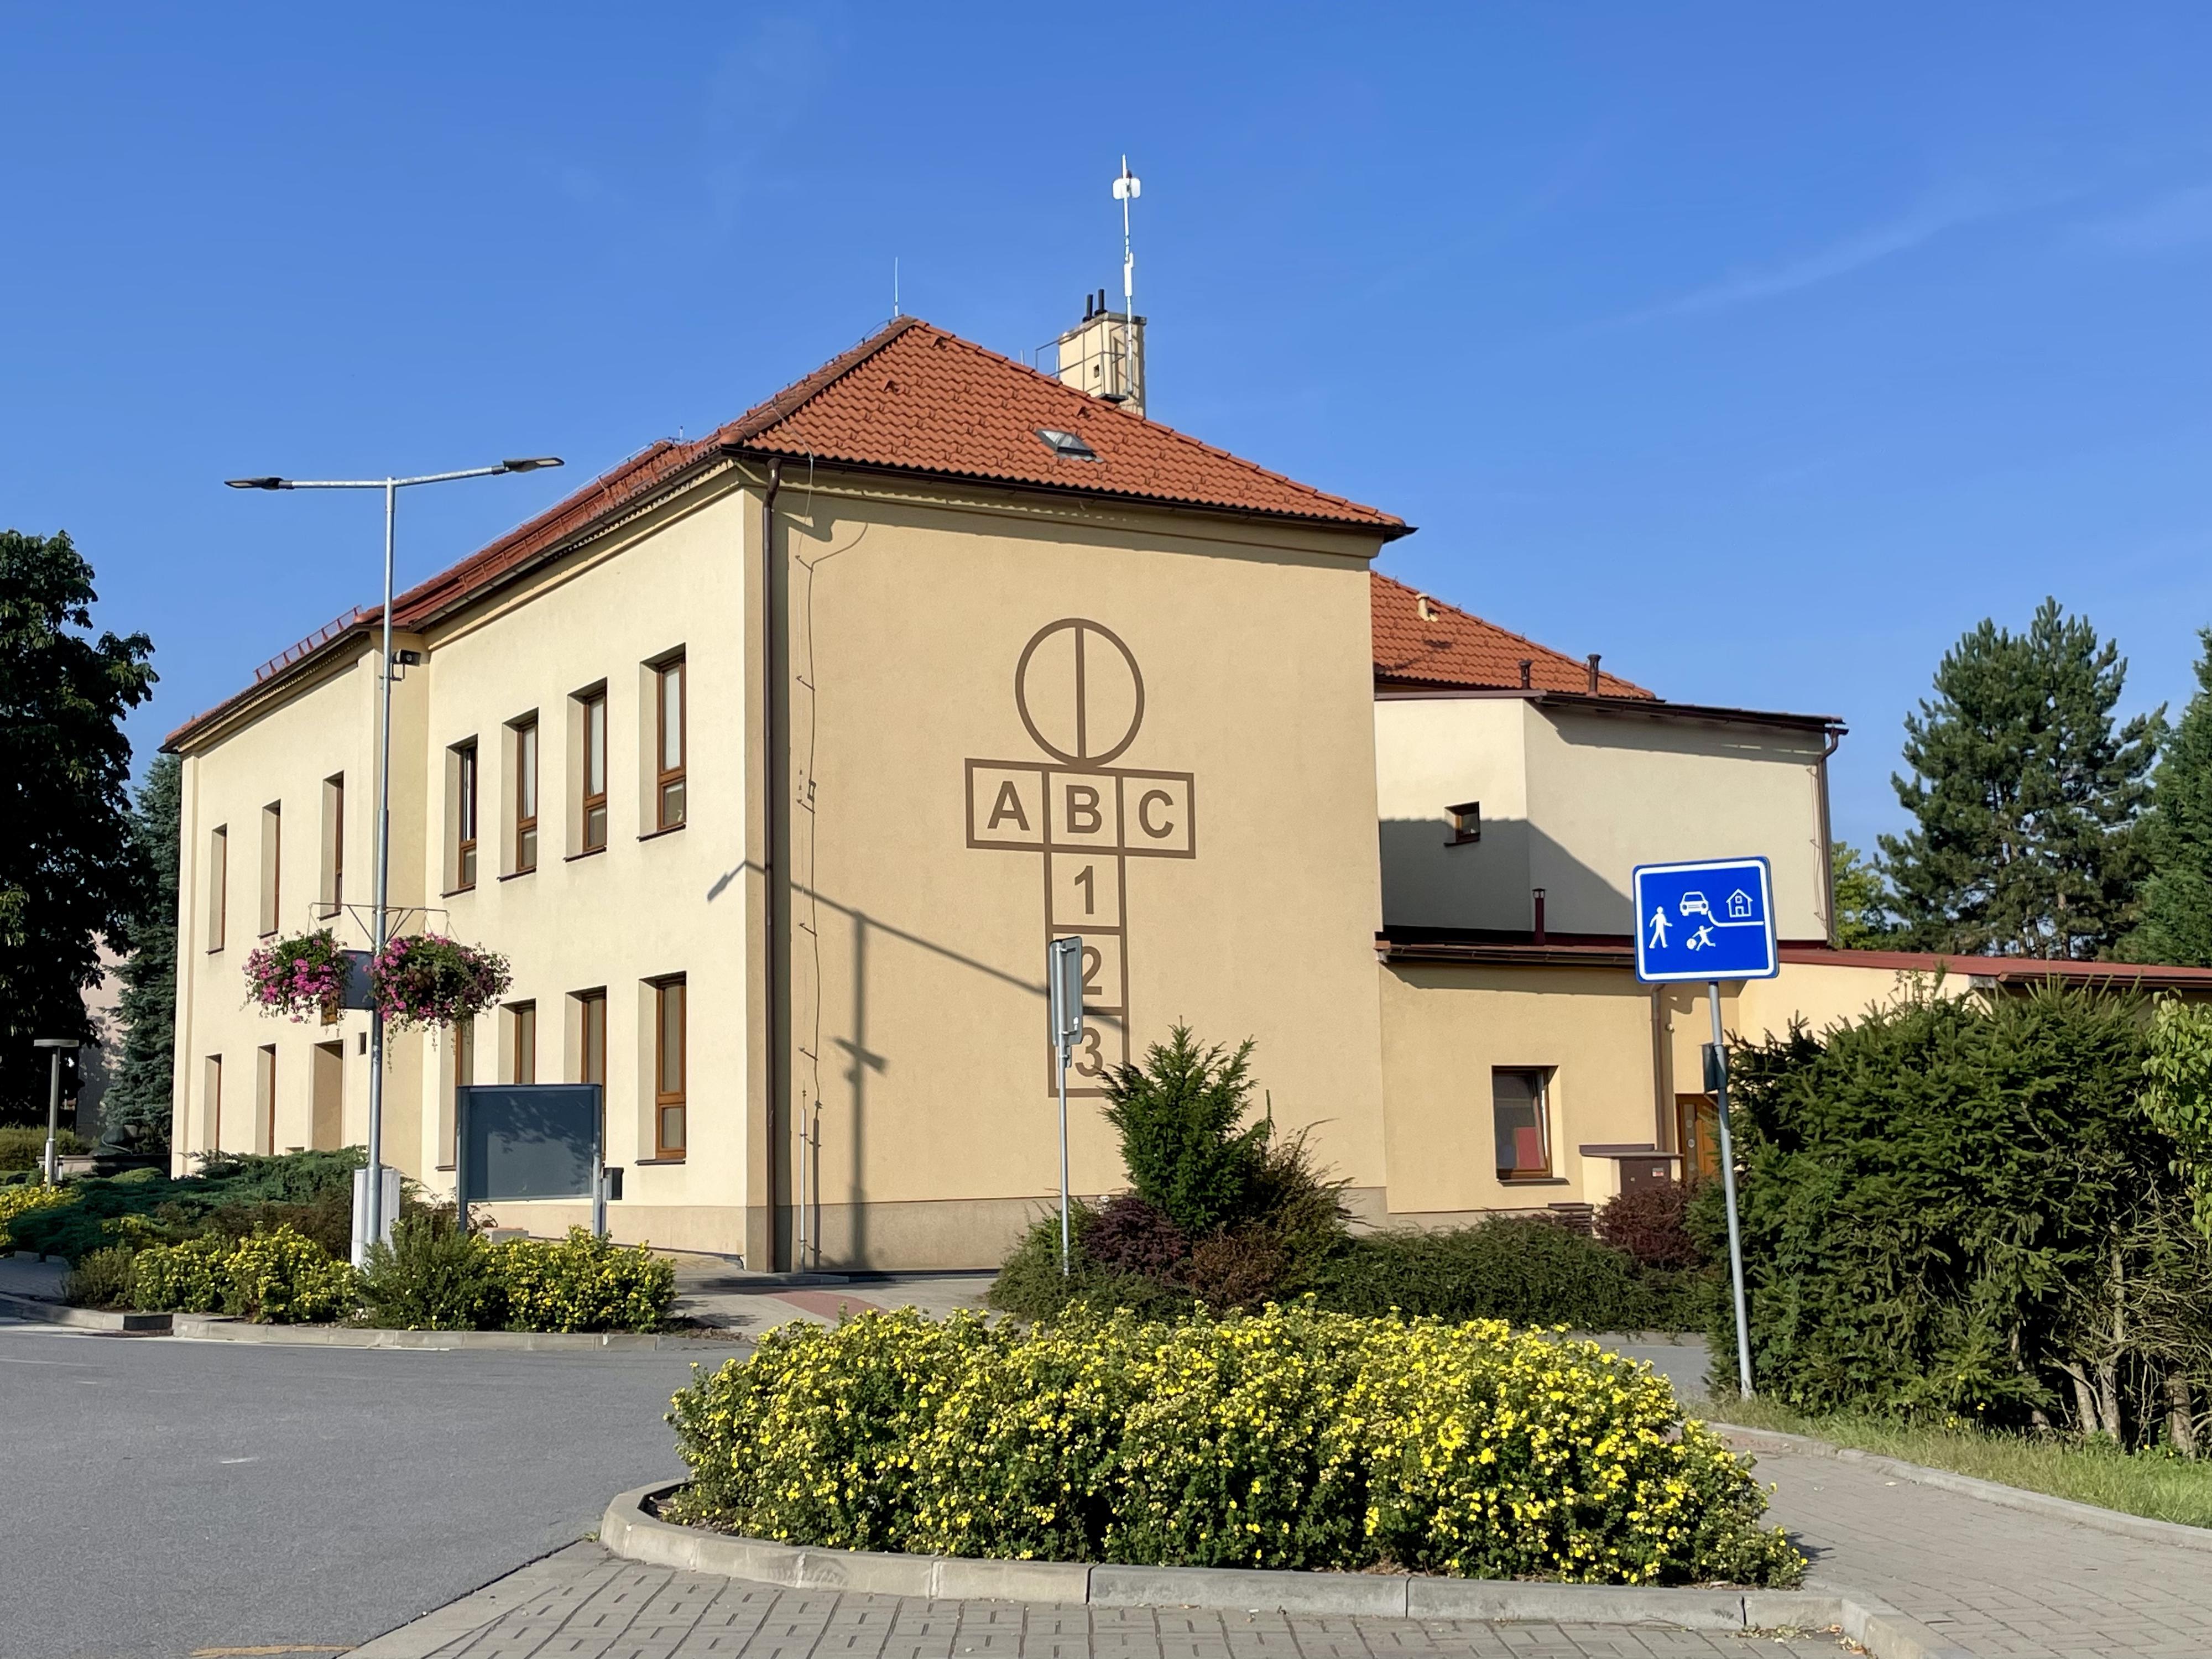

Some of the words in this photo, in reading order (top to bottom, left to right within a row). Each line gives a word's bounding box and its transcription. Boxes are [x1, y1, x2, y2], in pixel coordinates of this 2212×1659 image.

[987, 780, 1030, 831] A
[1066, 784, 1102, 834] B
[1139, 789, 1175, 839] C
[1074, 865, 1094, 915] 1
[1082, 946, 1103, 996] 2
[1074, 1026, 1103, 1077] 3
